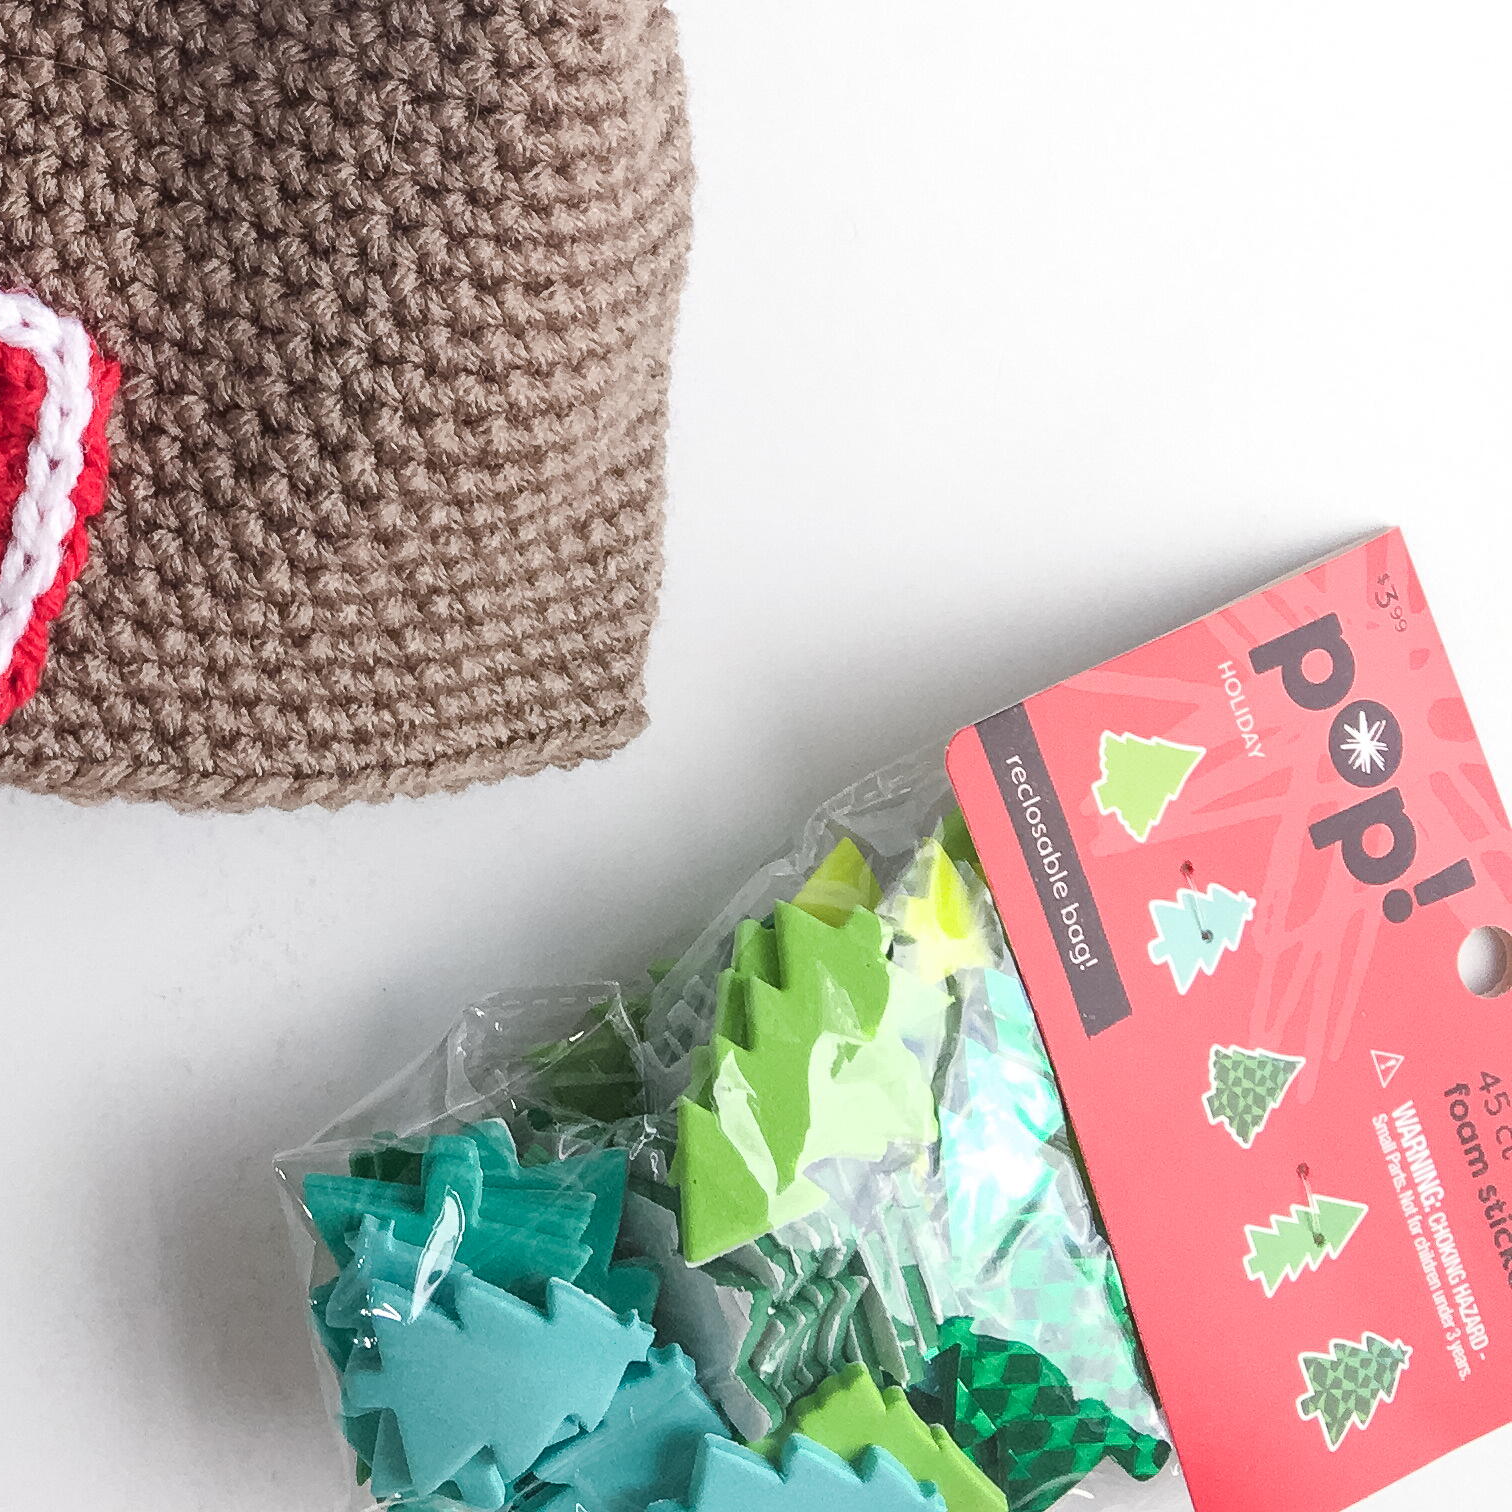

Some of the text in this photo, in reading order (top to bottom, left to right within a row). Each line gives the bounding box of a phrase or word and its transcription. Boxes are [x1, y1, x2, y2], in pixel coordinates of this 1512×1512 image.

[1217, 660, 1266, 760] HOLIDAY
[1005, 754, 1099, 971] reclosable bag!
[1443, 1082, 1489, 1178] foam
[1479, 1071, 1511, 1116] 45
[1371, 1113, 1472, 1382] Small Parts. Not for children under 3 years.
[1391, 1099, 1445, 1213] WARNING:
[1428, 1211, 1467, 1286] CHOKING
[1451, 1283, 1489, 1351] HAZARD
